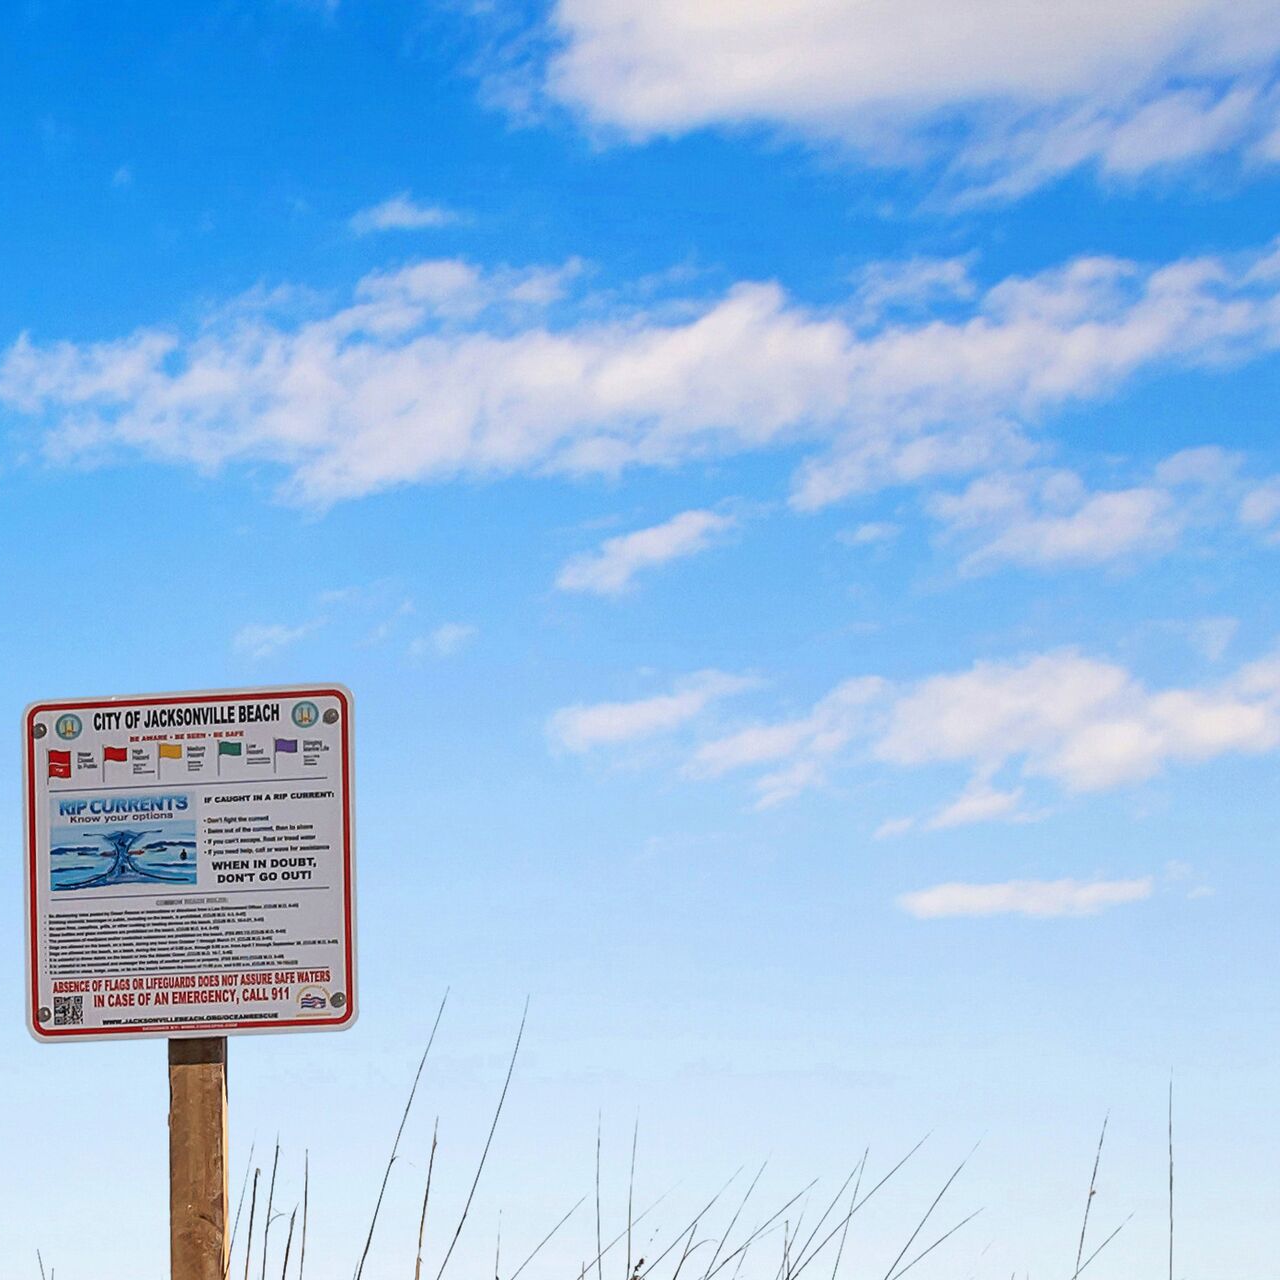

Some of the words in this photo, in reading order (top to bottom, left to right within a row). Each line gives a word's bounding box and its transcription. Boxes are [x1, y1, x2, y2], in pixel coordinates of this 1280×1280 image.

[94, 712, 121, 731] CITY
[125, 711, 140, 729] OF
[144, 705, 235, 728] JACKSONVILLE
[239, 704, 280, 723] BEACH
[215, 795, 250, 803] CAUGHT
[290, 791, 334, 799] CURRENT:
[60, 800, 87, 816] RIP
[90, 796, 188, 814] CURRENTS
[70, 816, 100, 824] Know
[104, 814, 128, 824] your
[132, 812, 173, 822] options
[212, 861, 249, 871] WHEN
[253, 859, 266, 868] IN
[270, 857, 317, 868] DOUBT,
[217, 873, 255, 884] DON'T
[259, 872, 277, 881] GO
[281, 871, 312, 880] OUT!
[53, 981, 90, 993] ABSENCE
[92, 980, 102, 992] OF
[104, 979, 130, 991] FLAGS
[132, 978, 143, 990] OR
[146, 976, 195, 989] LIFEGUARDS
[198, 975, 219, 987] DOES
[221, 974, 238, 986] NOT
[240, 973, 272, 985] ASSURE
[275, 972, 295, 984] SAFE
[296, 970, 330, 983] WATERS
[94, 995, 104, 1007] IN
[108, 994, 135, 1007] CASE
[138, 993, 151, 1006] OF
[154, 992, 169, 1005] AN
[172, 989, 239, 1004] EMERGENCY,
[242, 988, 268, 1001] CALL
[272, 987, 289, 1000] 911
